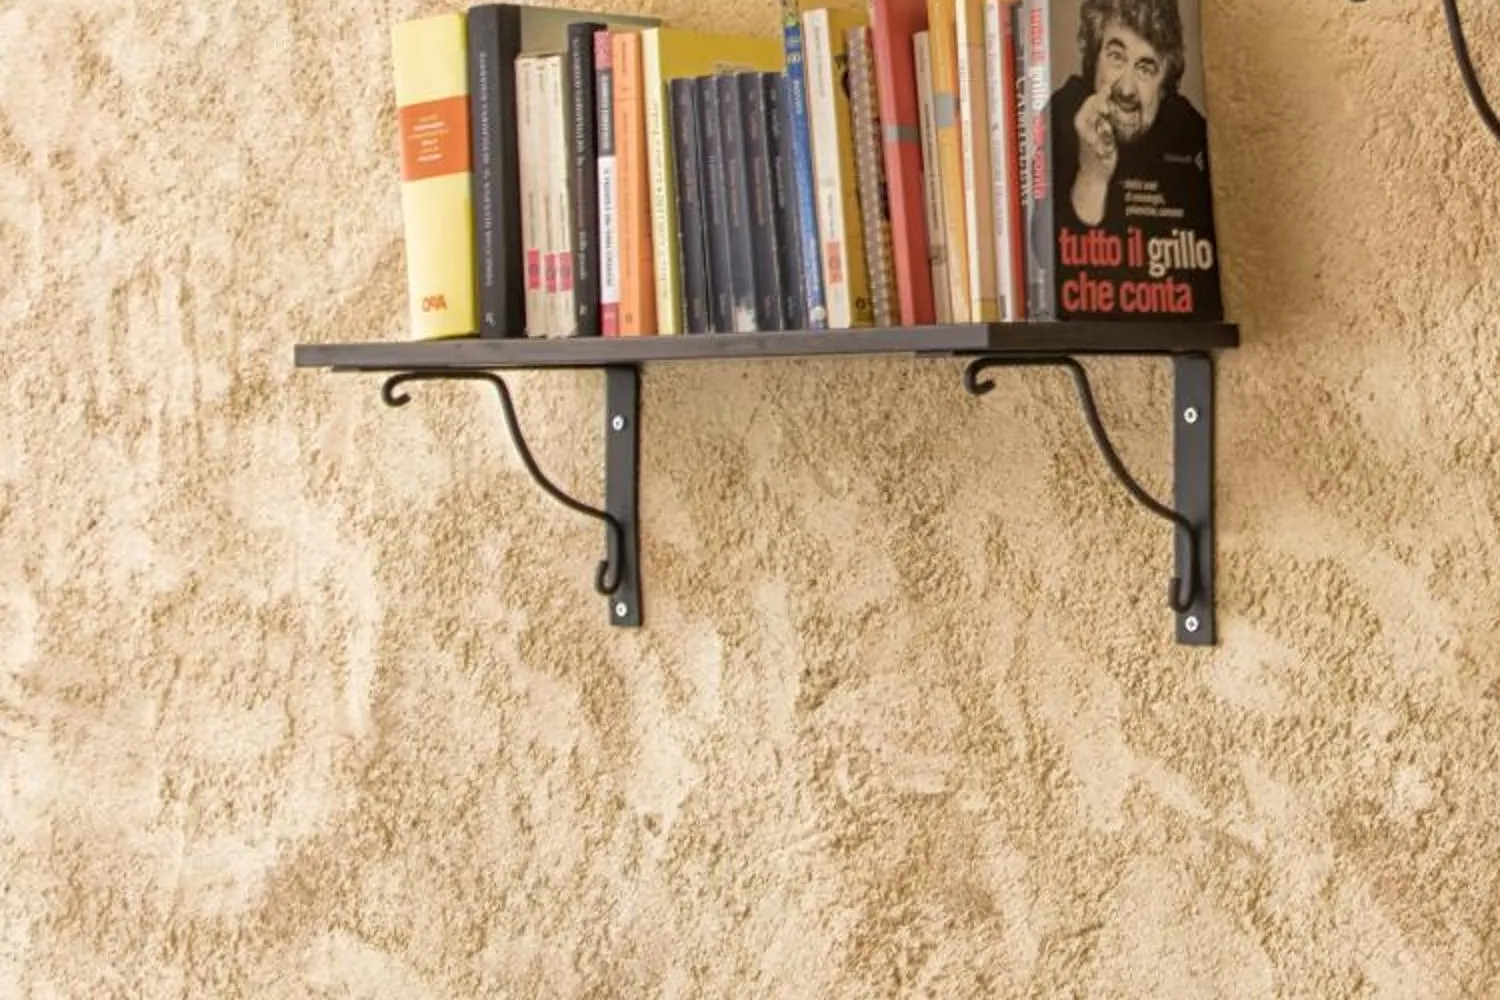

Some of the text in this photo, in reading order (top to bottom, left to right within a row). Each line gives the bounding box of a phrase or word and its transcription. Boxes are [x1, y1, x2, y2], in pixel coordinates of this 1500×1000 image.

[1059, 227, 1213, 274] tutto il grillo
[1062, 271, 1193, 314] che conta
